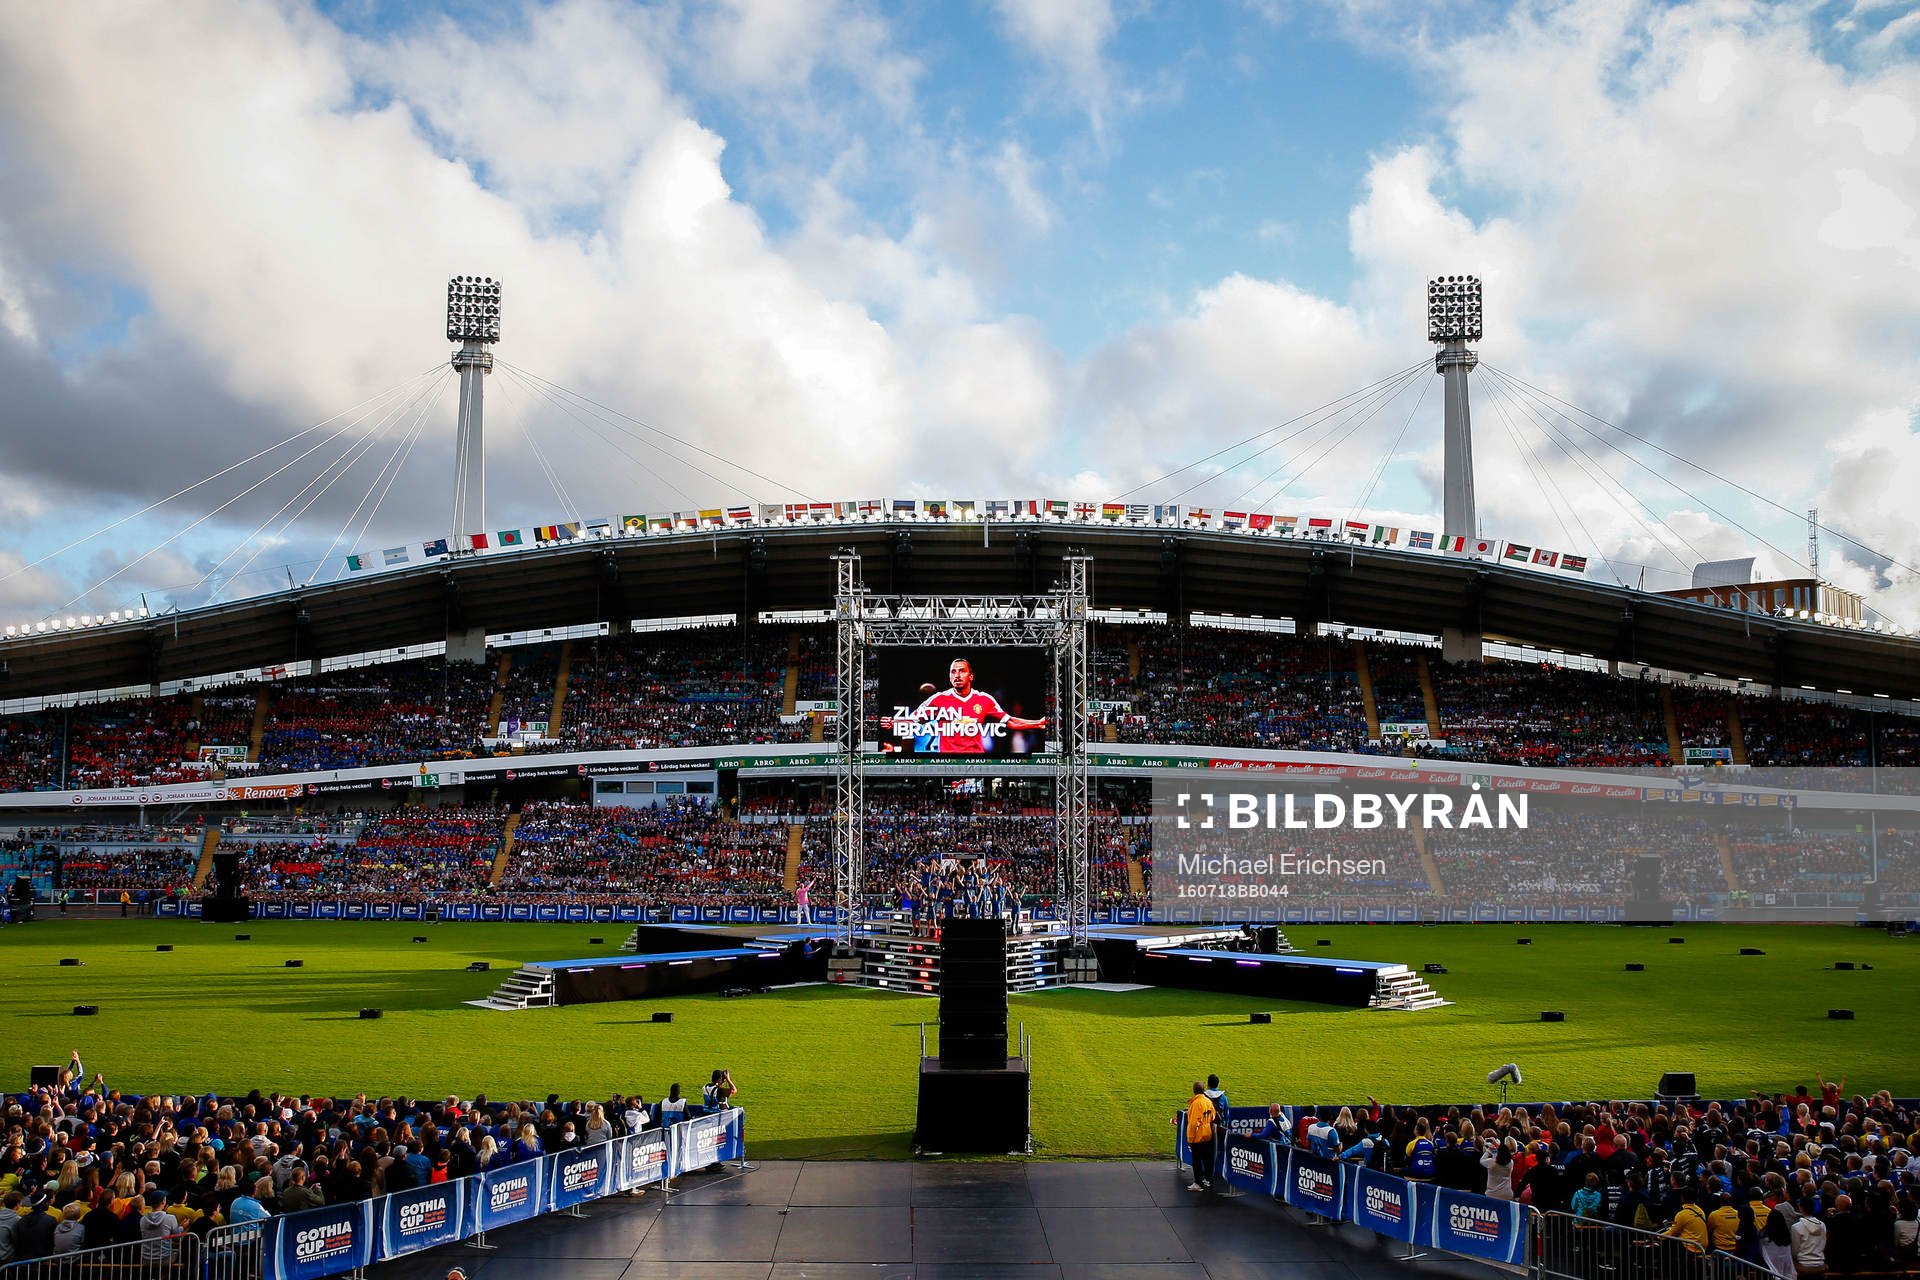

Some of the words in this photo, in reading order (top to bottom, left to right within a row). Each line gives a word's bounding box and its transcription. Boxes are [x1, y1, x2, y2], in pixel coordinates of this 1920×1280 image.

[893, 706, 962, 720] ZLATAN
[1214, 761, 1243, 770] Estrella
[1247, 763, 1276, 772] Estrella
[1285, 764, 1314, 774] Estrella
[1318, 766, 1347, 775] Estrella
[1356, 768, 1386, 778] Estrella
[1390, 771, 1419, 780] Estrella
[1429, 773, 1458, 783] Estrella
[1496, 779, 1526, 788] Estrella
[1531, 782, 1561, 790] Estrella
[1571, 784, 1601, 793] Estrella
[244, 787, 287, 799] Renova
[1605, 787, 1636, 796] Estrella
[1231, 1119, 1267, 1128] GOTHI
[697, 1124, 727, 1140] GOTHIA
[632, 1141, 667, 1157] GOTHIA
[697, 1137, 712, 1149] CUP
[632, 1155, 649, 1167] CUP
[1231, 1146, 1264, 1165] GOTHIA
[563, 1158, 598, 1176] GOTHIA
[1231, 1157, 1248, 1169] CUP
[491, 1176, 528, 1195] GOTHIA
[563, 1173, 582, 1187] CUP
[1298, 1176, 1315, 1190] CUP
[491, 1192, 510, 1206] CUP
[1366, 1185, 1401, 1206] GOTHIA
[400, 1197, 446, 1217] GOTHIA
[1366, 1196, 1384, 1210] CUP
[1450, 1203, 1499, 1222] GOTHIA
[400, 1214, 424, 1229] CUP
[1450, 1215, 1474, 1230] CUP
[296, 1220, 352, 1243] GOTHIA
[296, 1239, 325, 1256] CUP
